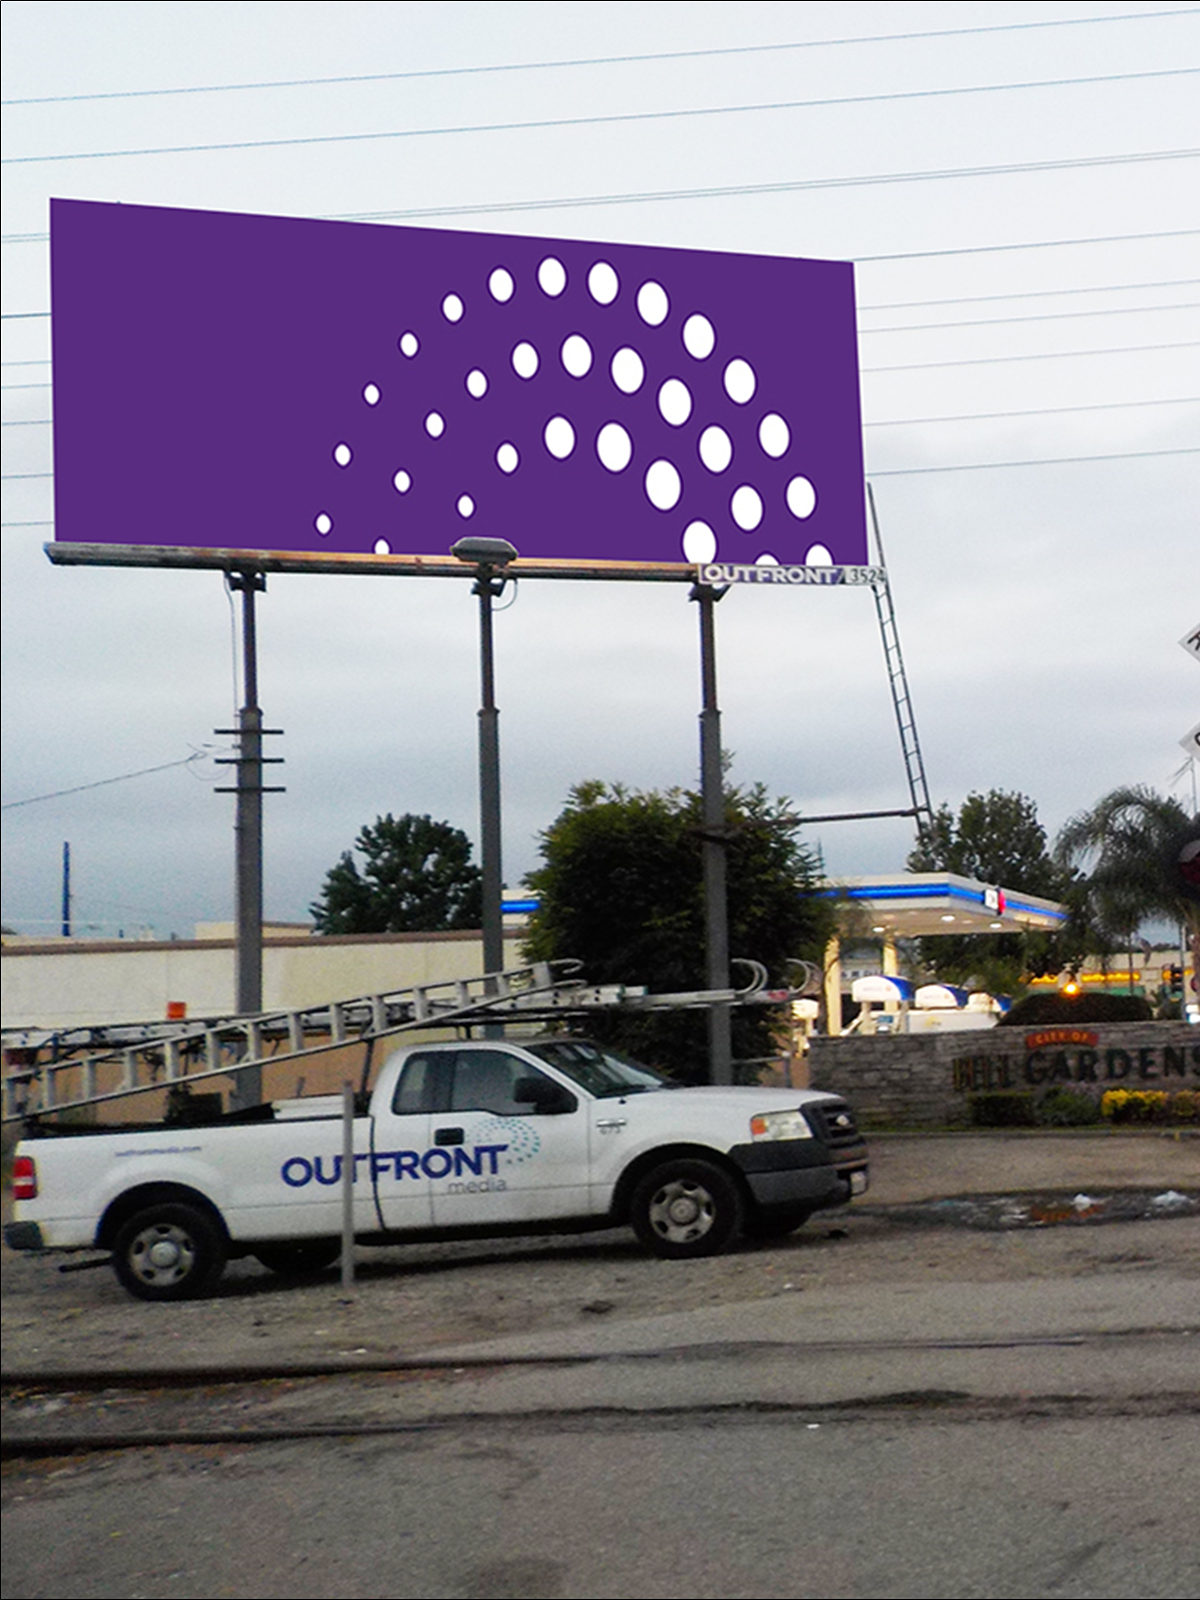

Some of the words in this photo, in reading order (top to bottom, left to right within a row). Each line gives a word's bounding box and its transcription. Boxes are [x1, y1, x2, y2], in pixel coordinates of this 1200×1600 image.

[704, 565, 837, 584] OUTFRONT
[1035, 1032, 1066, 1044] CITY
[1071, 1031, 1090, 1042] OF
[280, 1144, 509, 1188] OUTFRONT
[448, 1177, 508, 1194] media
